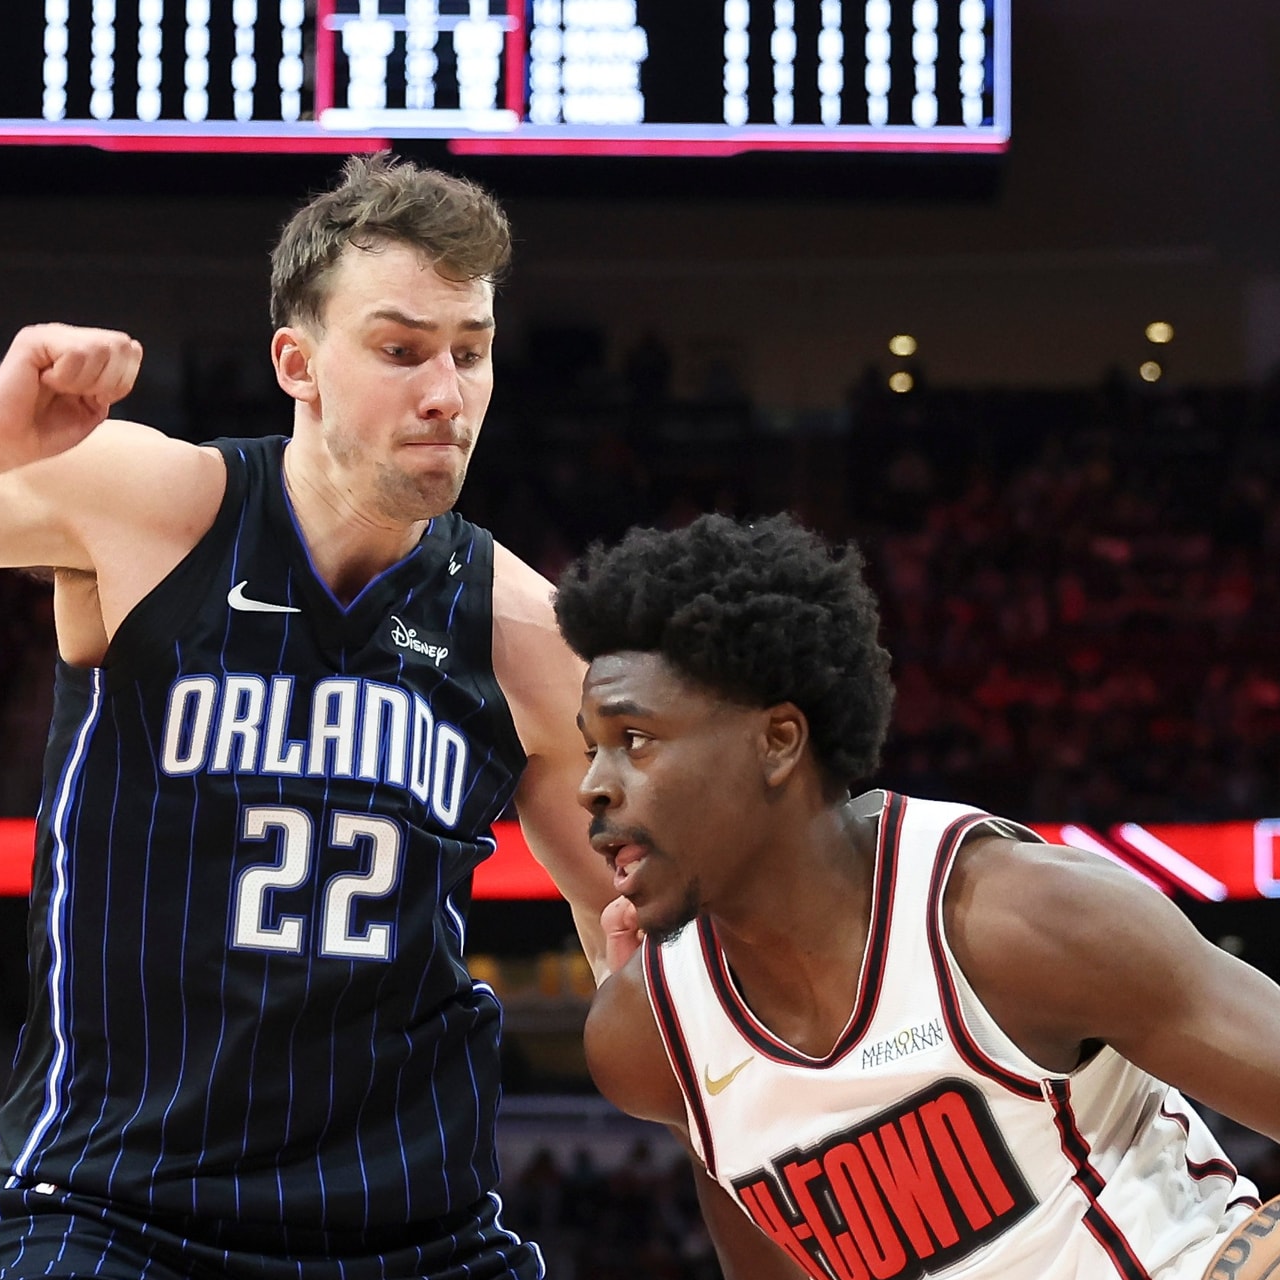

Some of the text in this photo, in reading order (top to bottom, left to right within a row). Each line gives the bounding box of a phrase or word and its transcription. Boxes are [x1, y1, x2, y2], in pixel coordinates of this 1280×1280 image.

[161, 673, 468, 829] ORLANDO
[229, 804, 402, 963] 22
[861, 1027, 944, 1070] HERMANN
[862, 1018, 942, 1060] MEMORIAL
